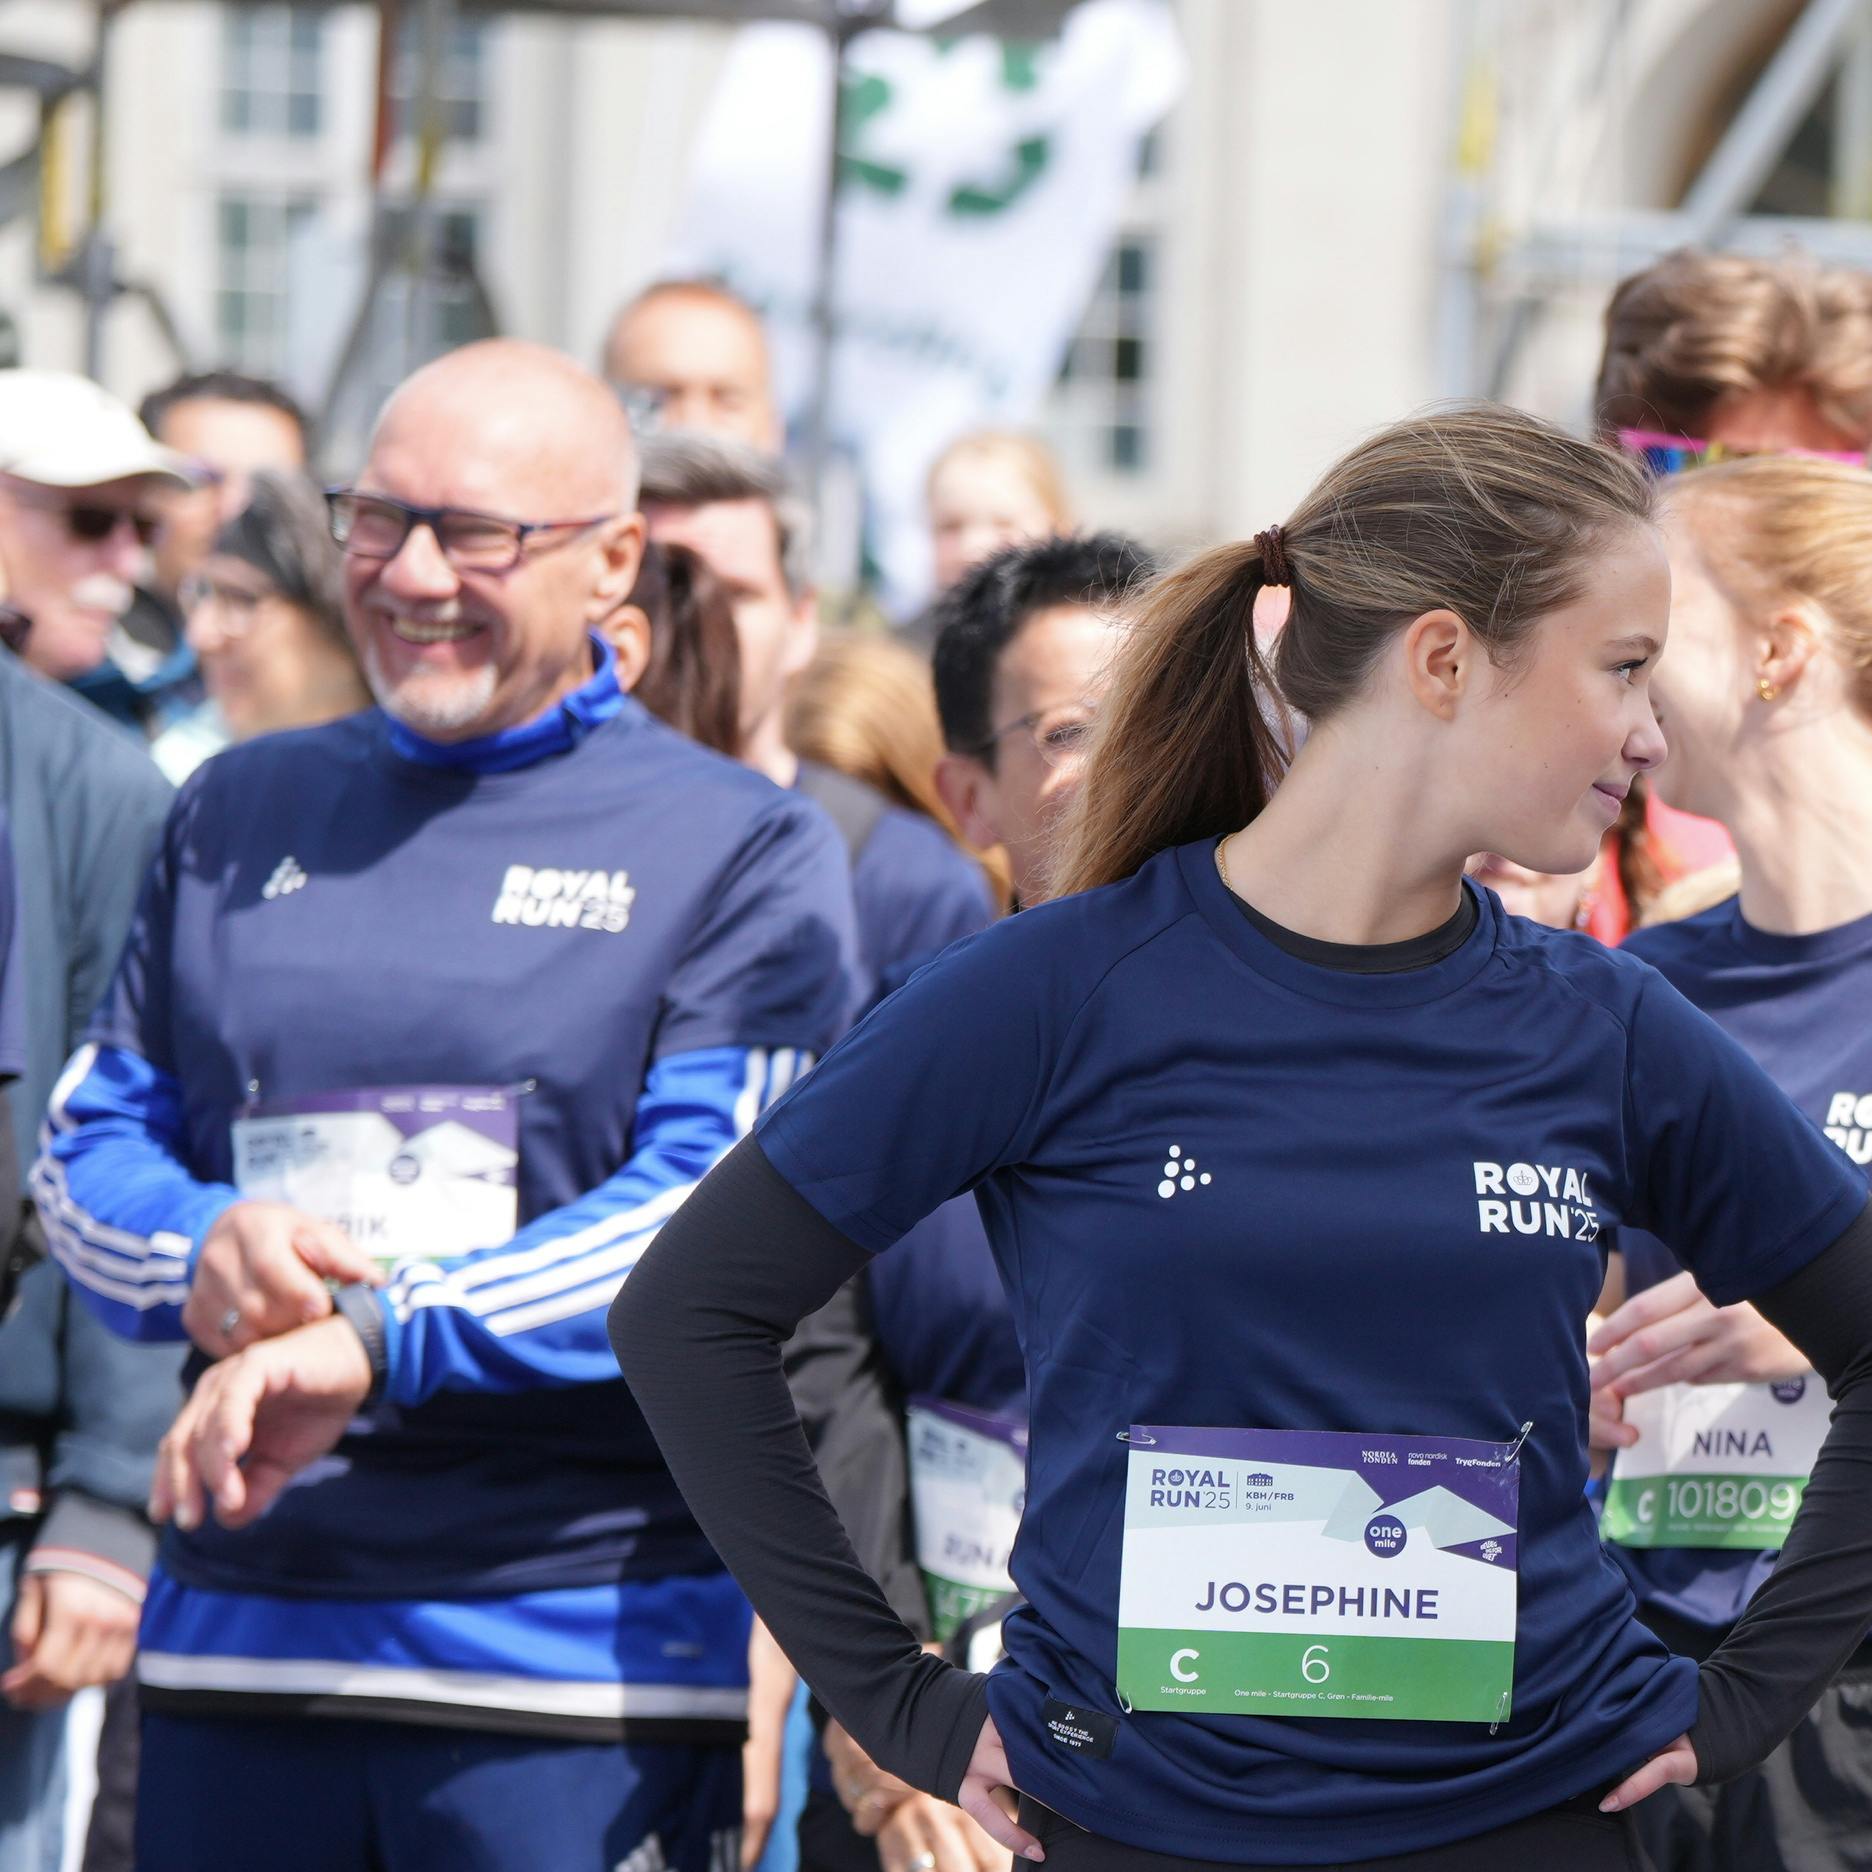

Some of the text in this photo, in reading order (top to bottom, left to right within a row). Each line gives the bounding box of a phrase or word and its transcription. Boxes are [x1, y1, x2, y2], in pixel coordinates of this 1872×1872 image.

[501, 864, 635, 903] ROYAL
[1473, 1161, 1592, 1207] ROYAL
[1692, 1429, 1773, 1458] NINA
[1362, 1450, 1396, 1458] NORDEA
[1408, 1458, 1431, 1466] fonden
[1455, 1457, 1501, 1467] TrygFonden
[1152, 1469, 1230, 1487] ROYAL
[1246, 1491, 1294, 1501] KBH/FRB
[1255, 1502, 1272, 1511] juni
[1637, 1481, 1795, 1524] C 101809
[1369, 1526, 1402, 1538] one
[1374, 1539, 1396, 1548] mile
[1195, 1580, 1439, 1620] JOSEPHINE
[1169, 1644, 1330, 1684] C 6
[1160, 1686, 1207, 1696] Startgruppe
[1234, 1689, 1249, 1697] One
[1273, 1690, 1316, 1700] Startgruppe
